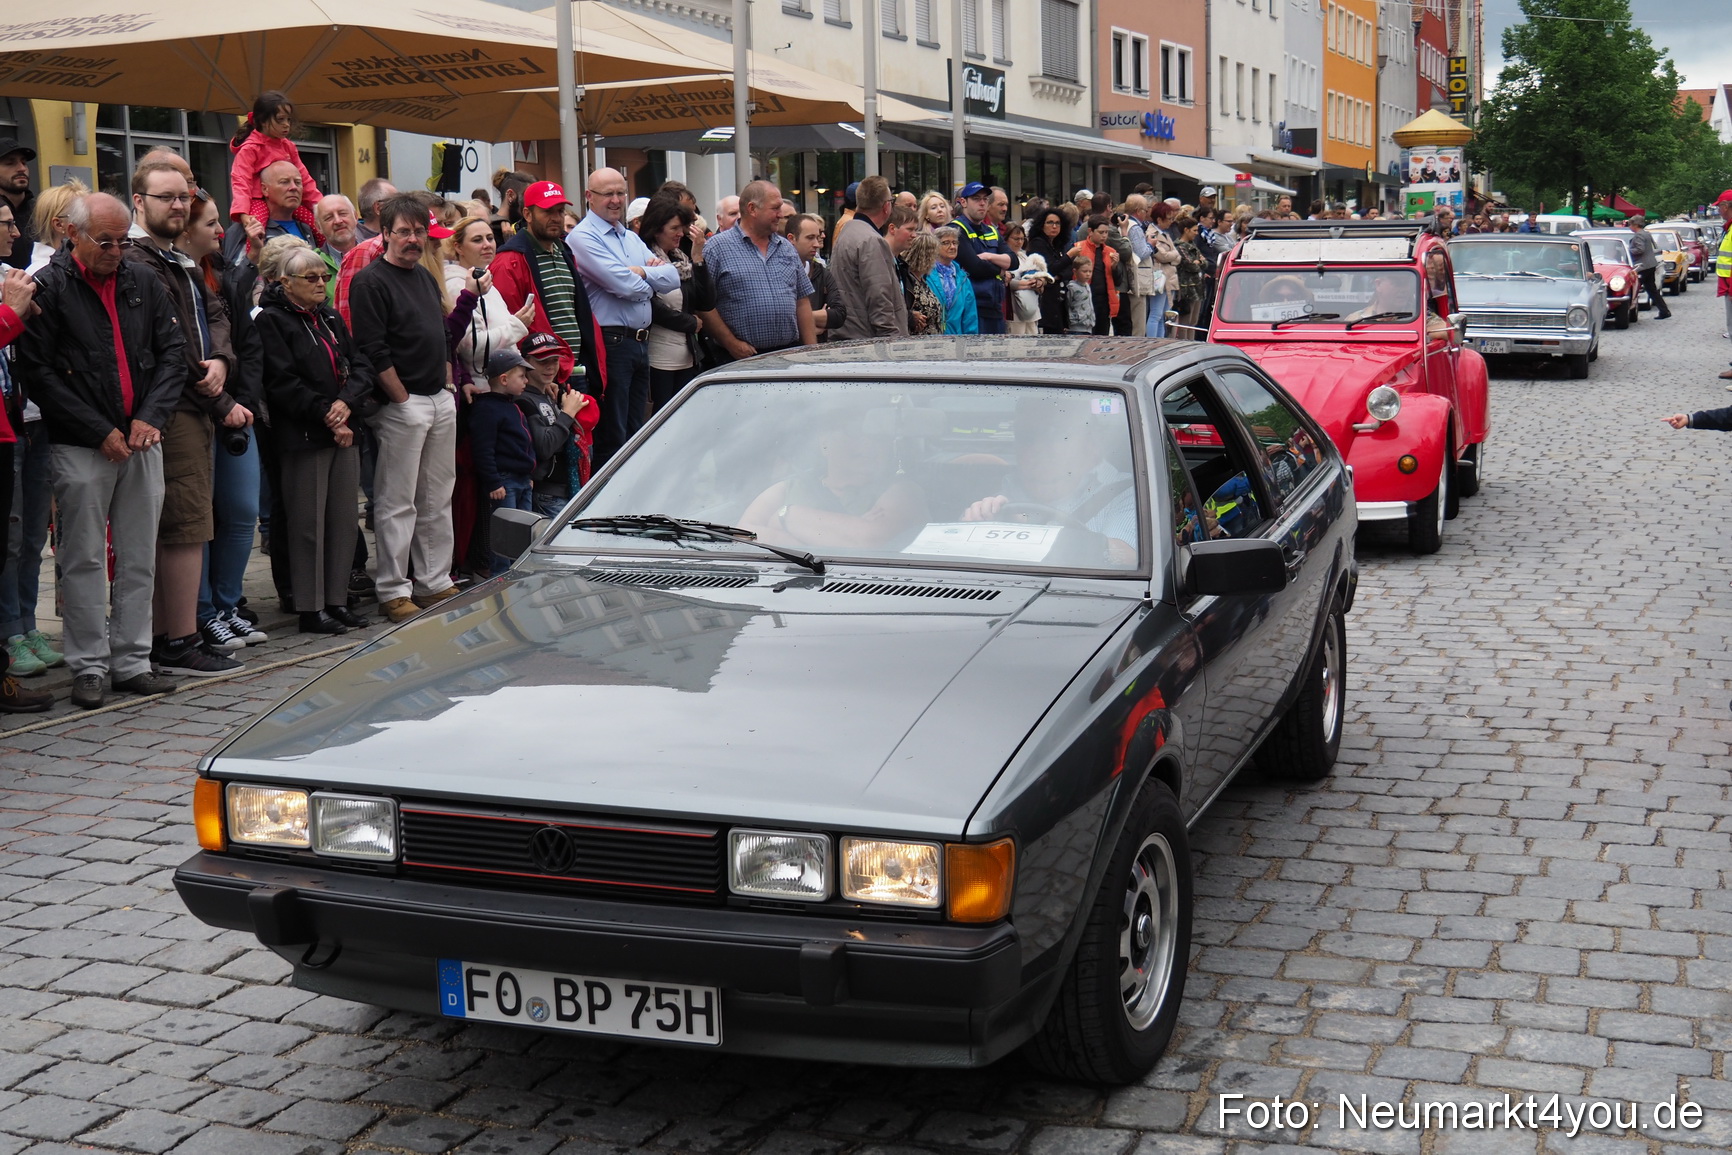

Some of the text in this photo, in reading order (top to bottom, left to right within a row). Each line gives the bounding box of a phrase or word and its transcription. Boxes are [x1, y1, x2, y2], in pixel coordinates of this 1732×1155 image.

[358, 147, 371, 164] 24
[985, 530, 1031, 540] 576
[448, 993, 457, 1006] D
[465, 968, 715, 1037] FO BP 75H
